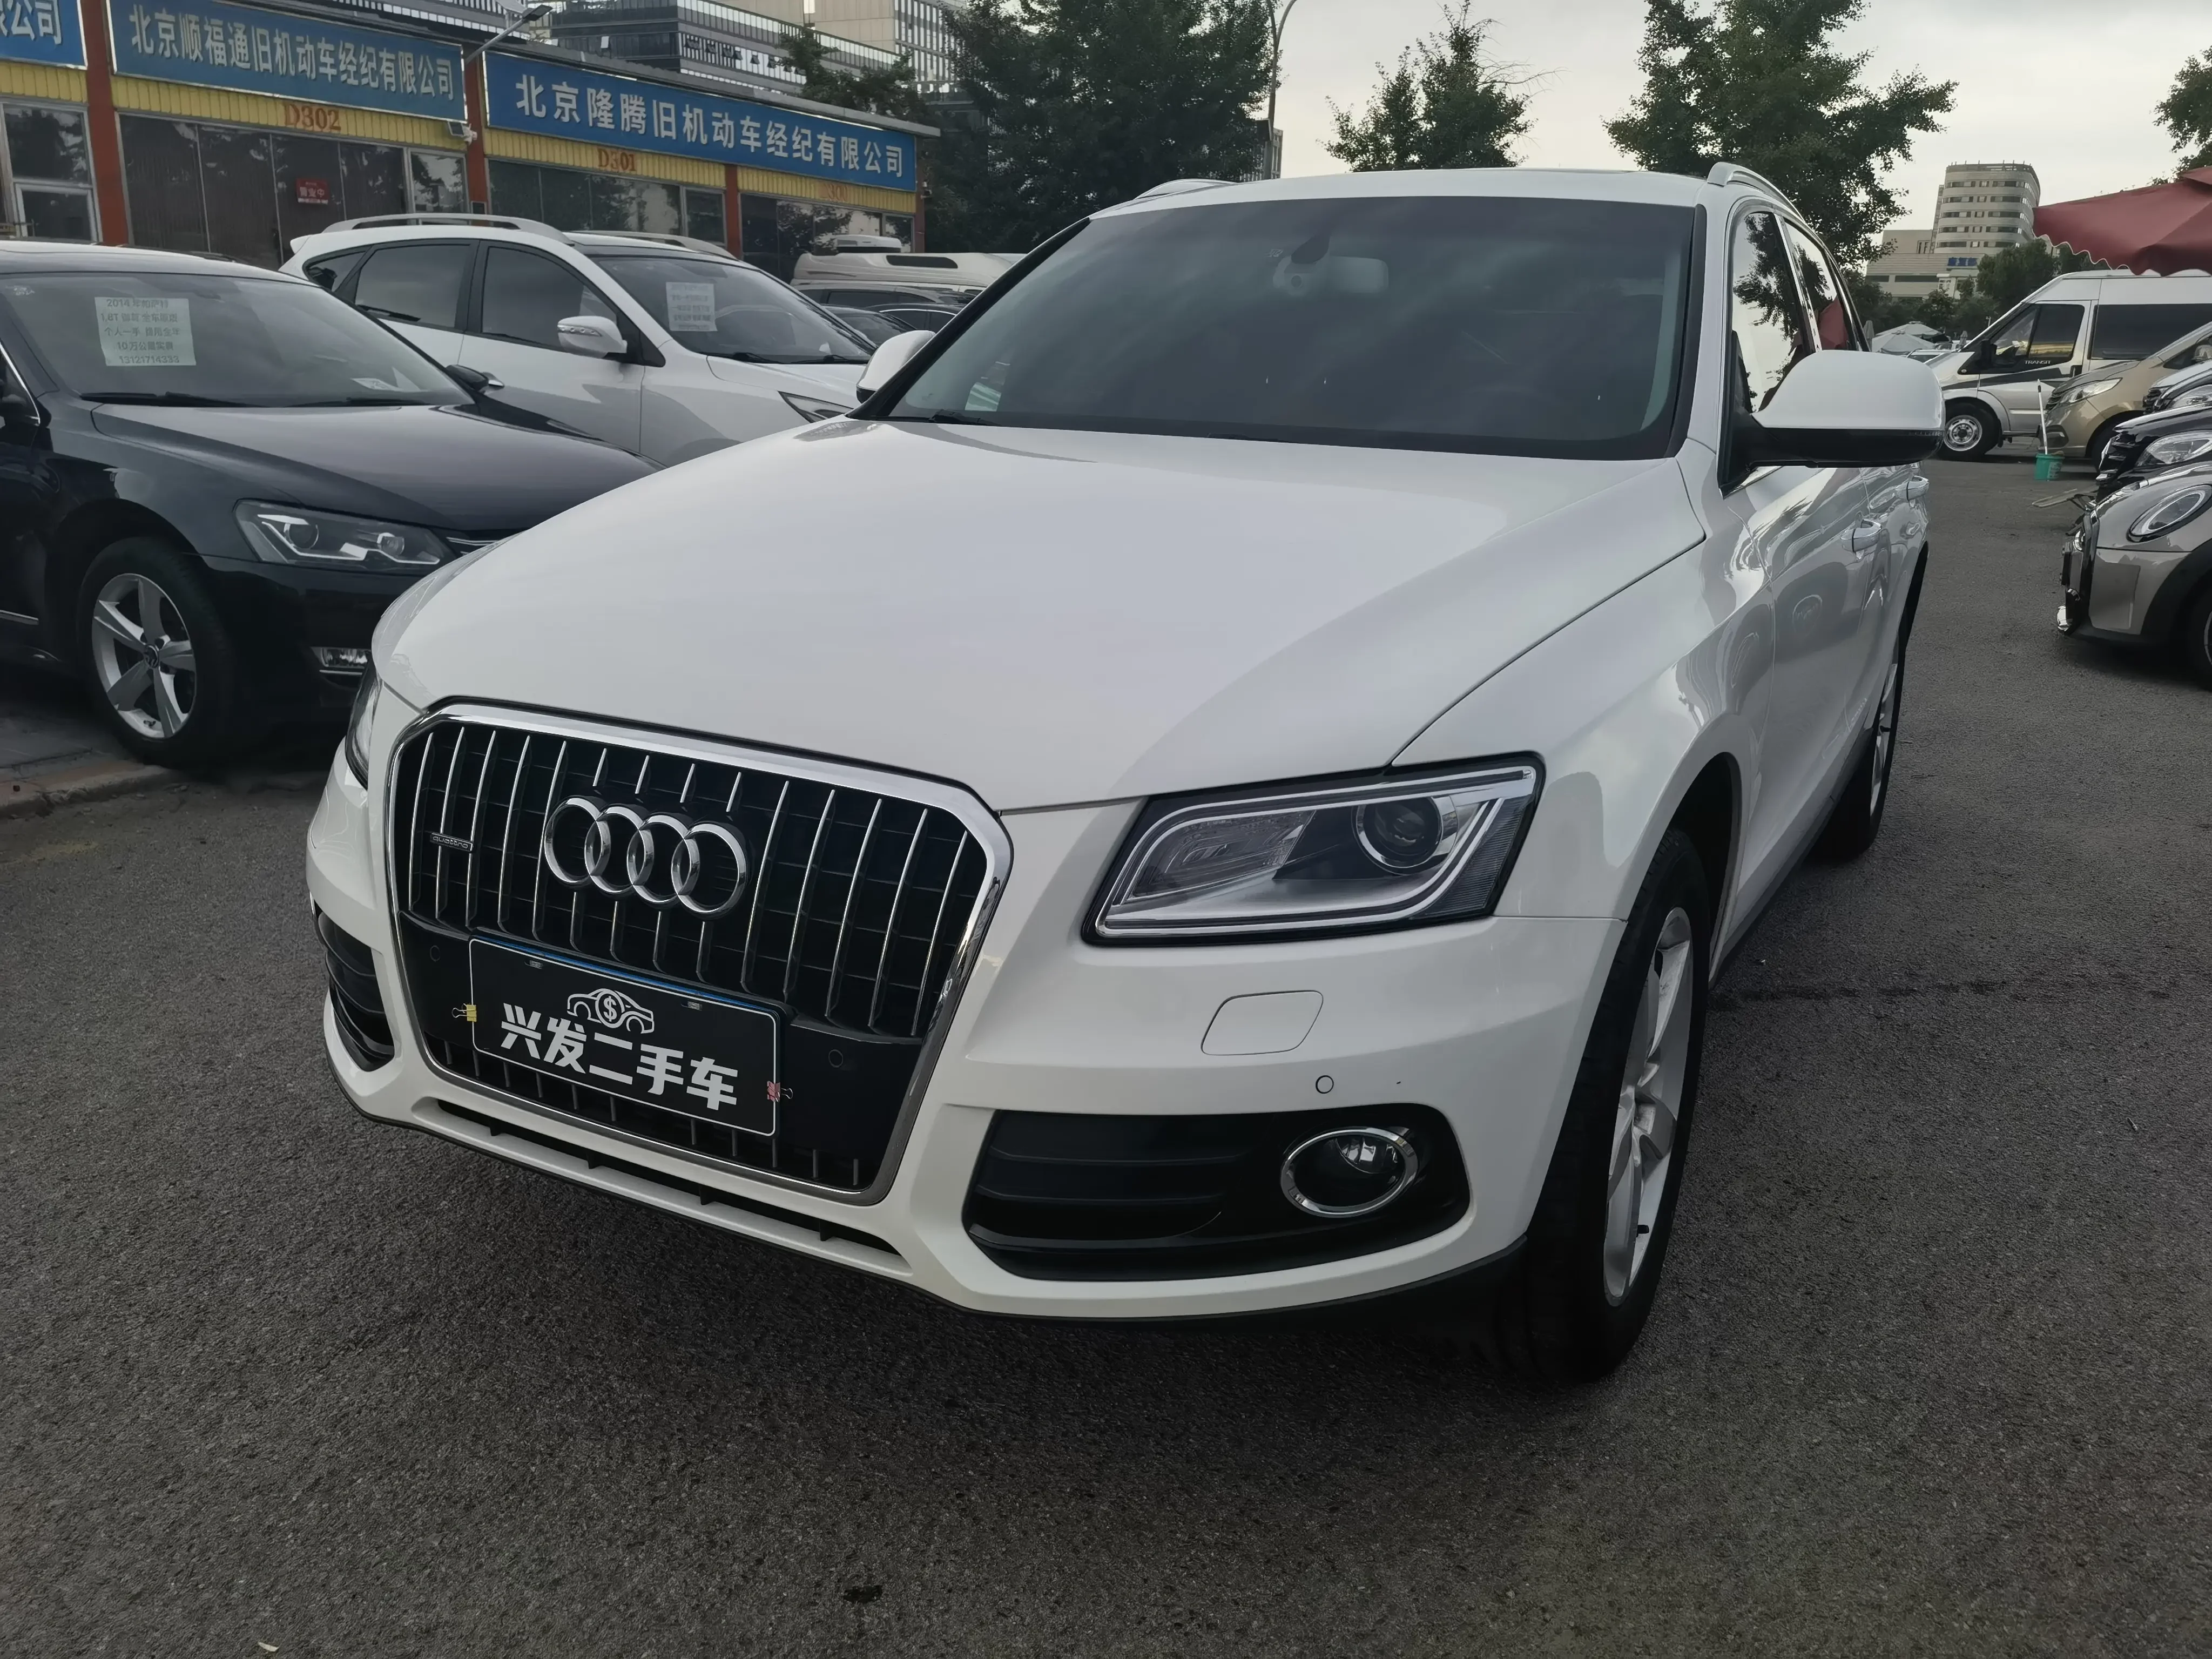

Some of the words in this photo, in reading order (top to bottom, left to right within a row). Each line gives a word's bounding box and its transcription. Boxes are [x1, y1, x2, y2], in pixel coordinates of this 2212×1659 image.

[130, 4, 454, 101] 北京顺福通旧机动车经纪有限公司
[282, 103, 341, 131] D302
[515, 73, 902, 178] 北京隆腾旧机动车经纪有限公司
[597, 148, 636, 171] D301
[106, 299, 130, 307] 2014
[433, 836, 468, 849] quattro
[501, 1002, 738, 1111] 兴发二手车
